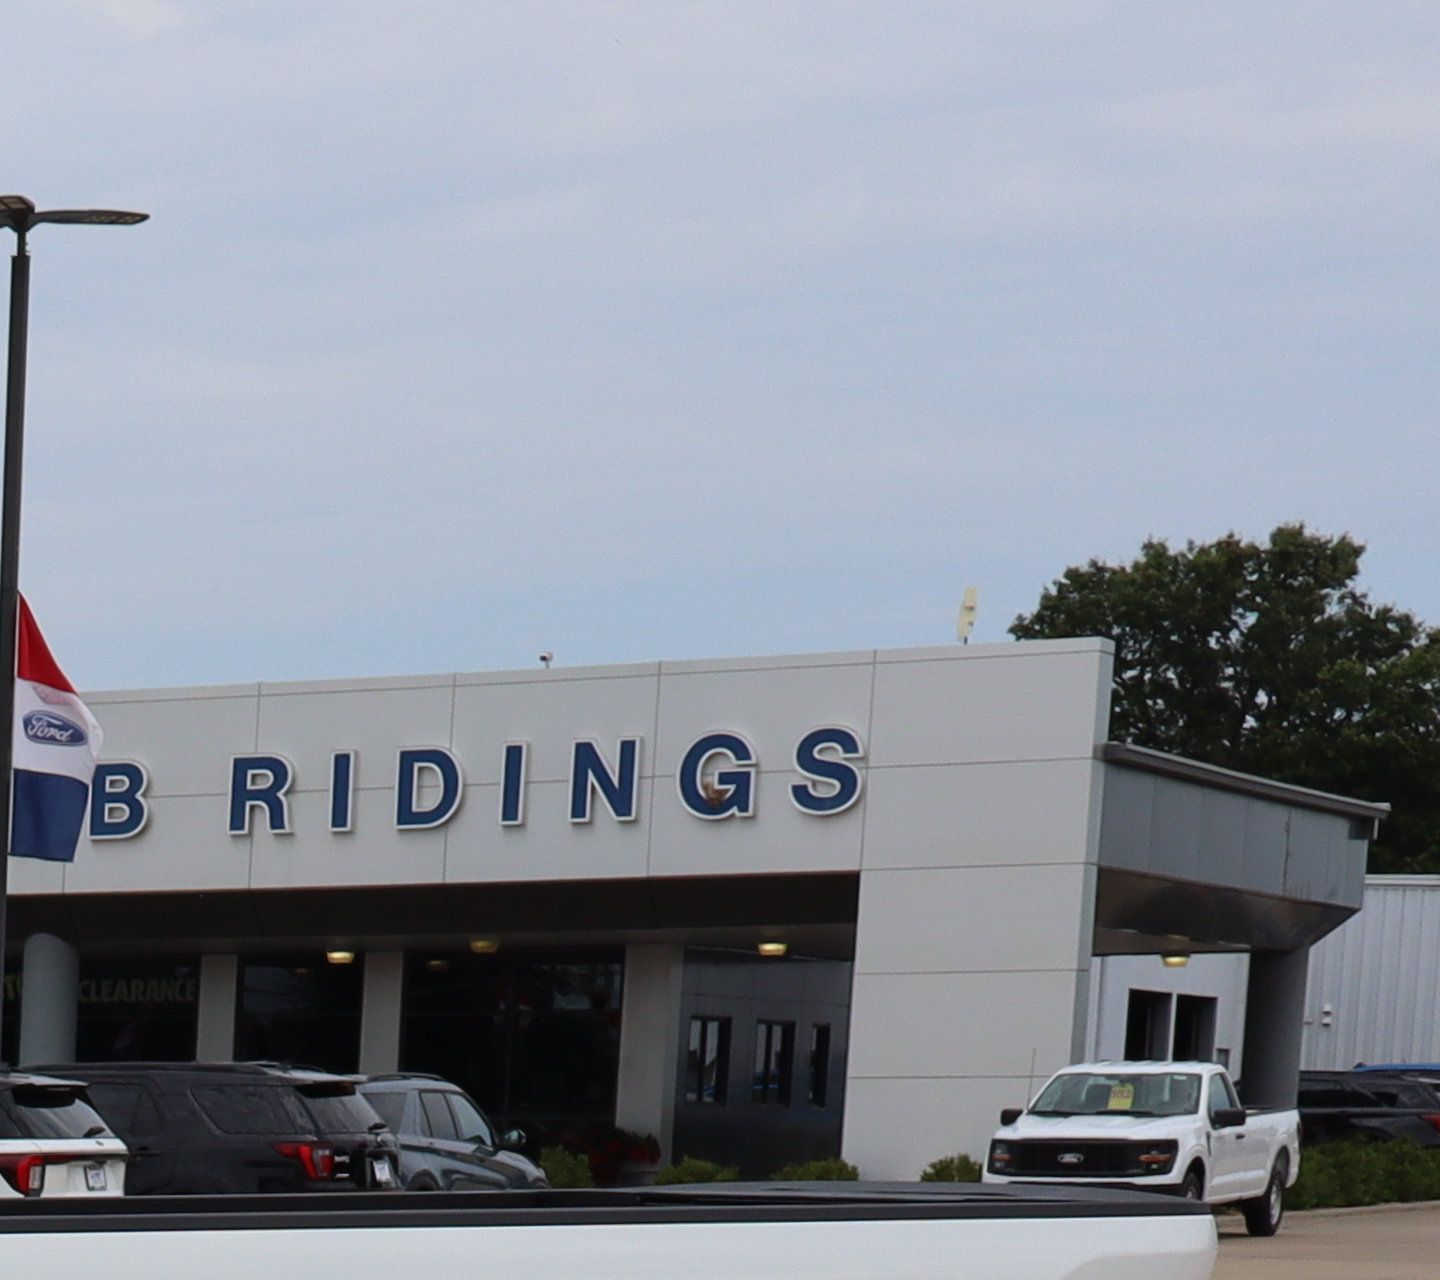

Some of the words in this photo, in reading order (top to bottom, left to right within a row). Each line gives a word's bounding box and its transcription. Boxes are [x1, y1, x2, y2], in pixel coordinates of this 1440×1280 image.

[27, 714, 74, 742] Ford
[227, 724, 867, 837] RIDINGS
[80, 978, 196, 1003] CLEARANCE
